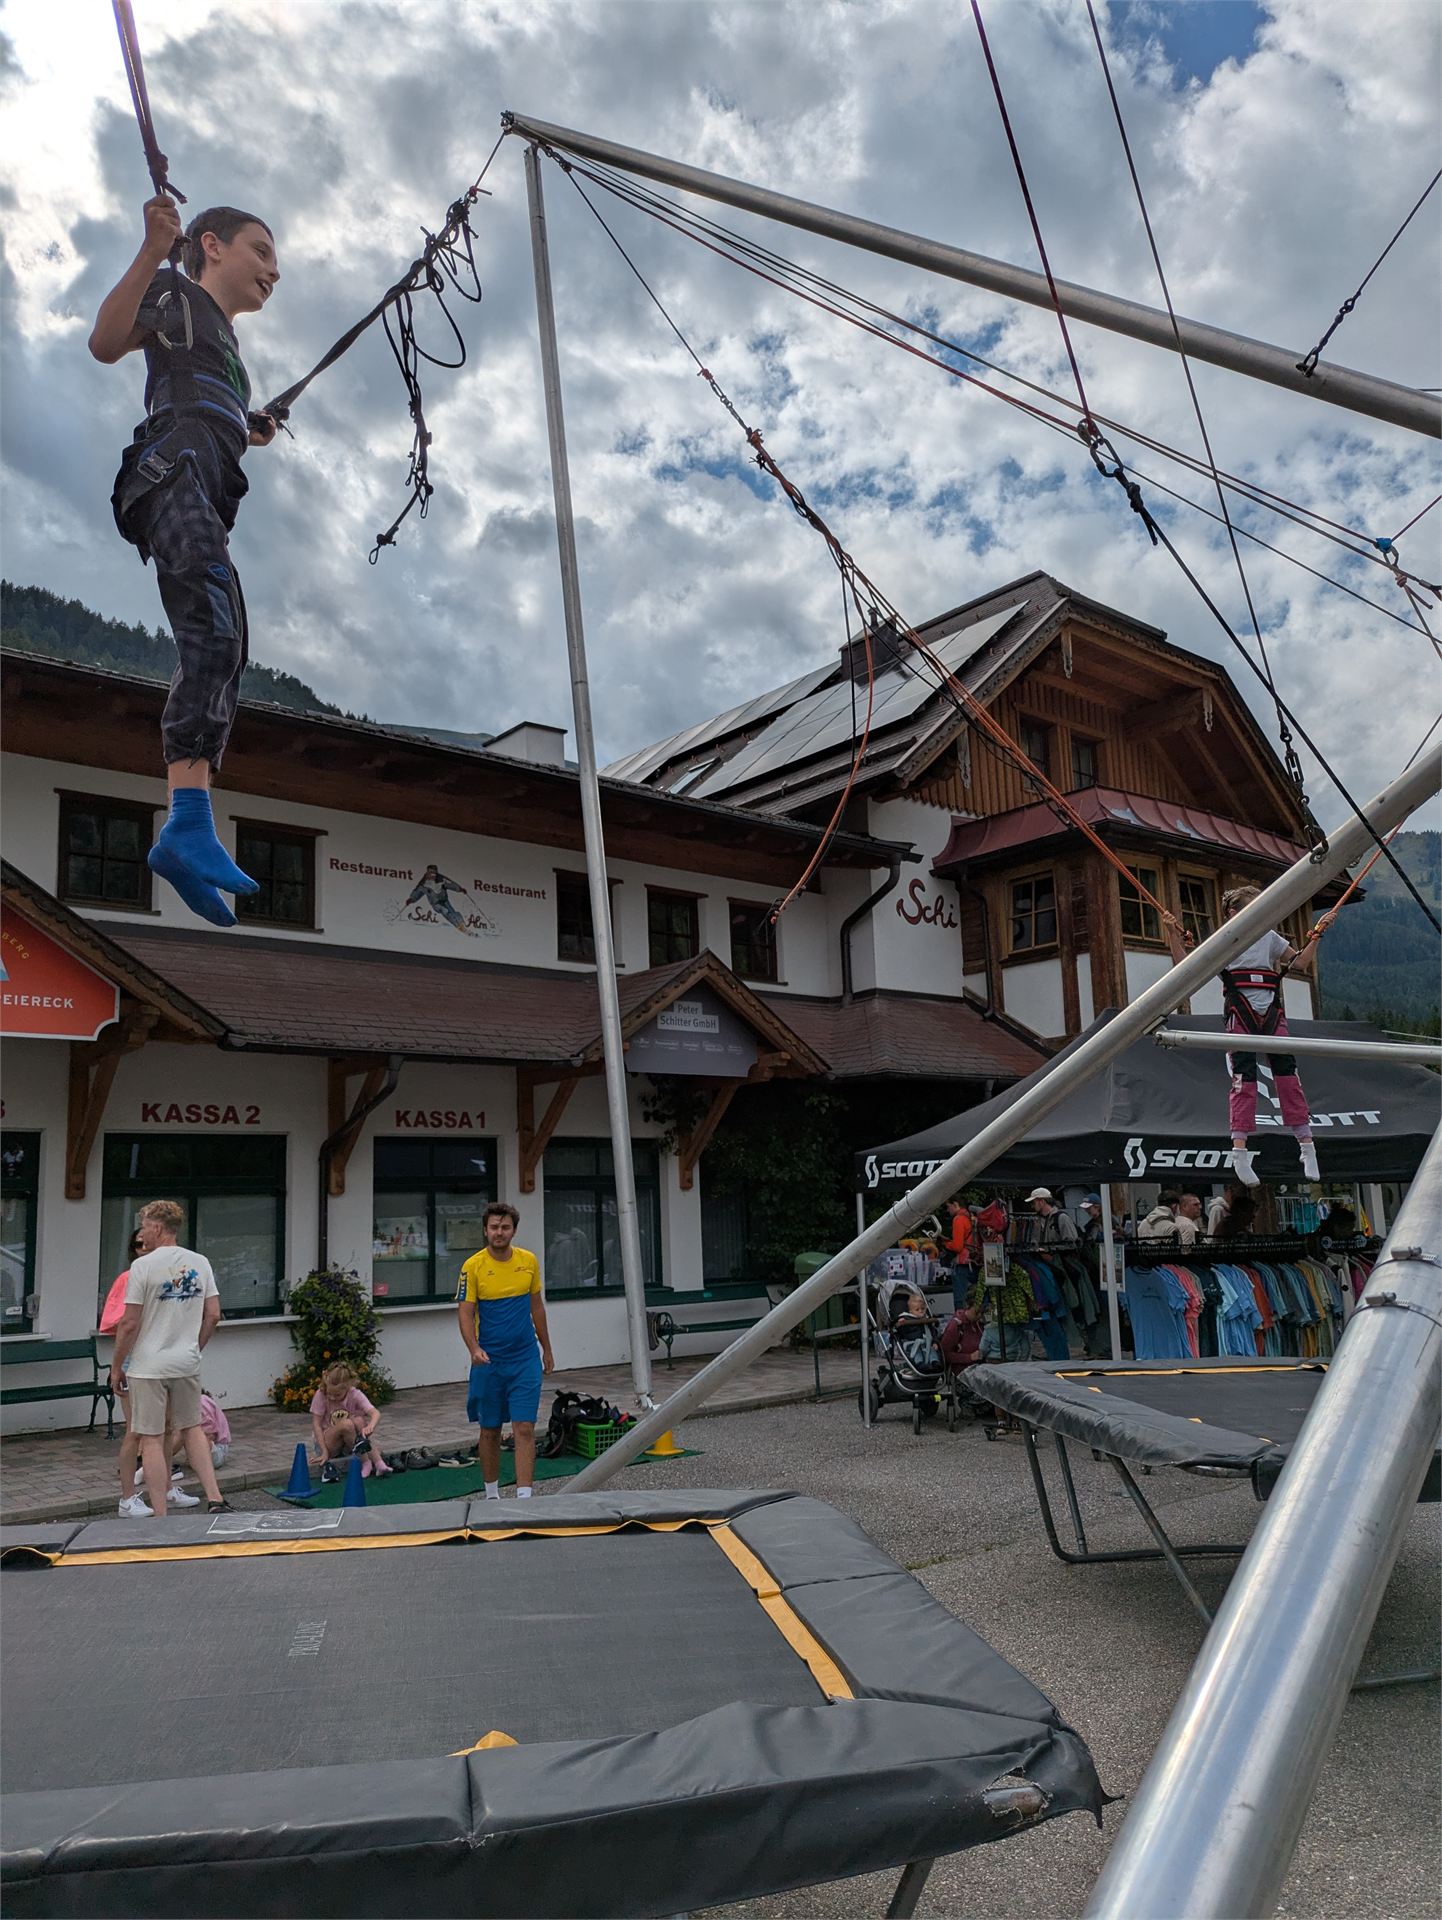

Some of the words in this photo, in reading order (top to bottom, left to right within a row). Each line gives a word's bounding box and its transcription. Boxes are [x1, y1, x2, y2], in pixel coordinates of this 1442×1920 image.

[329, 858, 413, 880] Restaurant
[473, 879, 546, 900] Restaurant
[896, 878, 958, 929] Schi
[408, 906, 439, 923] Schi
[465, 914, 487, 929] Alm
[0, 994, 74, 1009] EIERECK
[677, 1004, 699, 1015] Peter
[660, 1015, 691, 1027] Schitter
[692, 1018, 717, 1030] GmbH
[141, 1103, 241, 1125] KASSA
[245, 1105, 261, 1125] 2
[395, 1109, 473, 1129] KASSA
[476, 1111, 486, 1129] 1
[881, 1159, 949, 1179] SCOT
